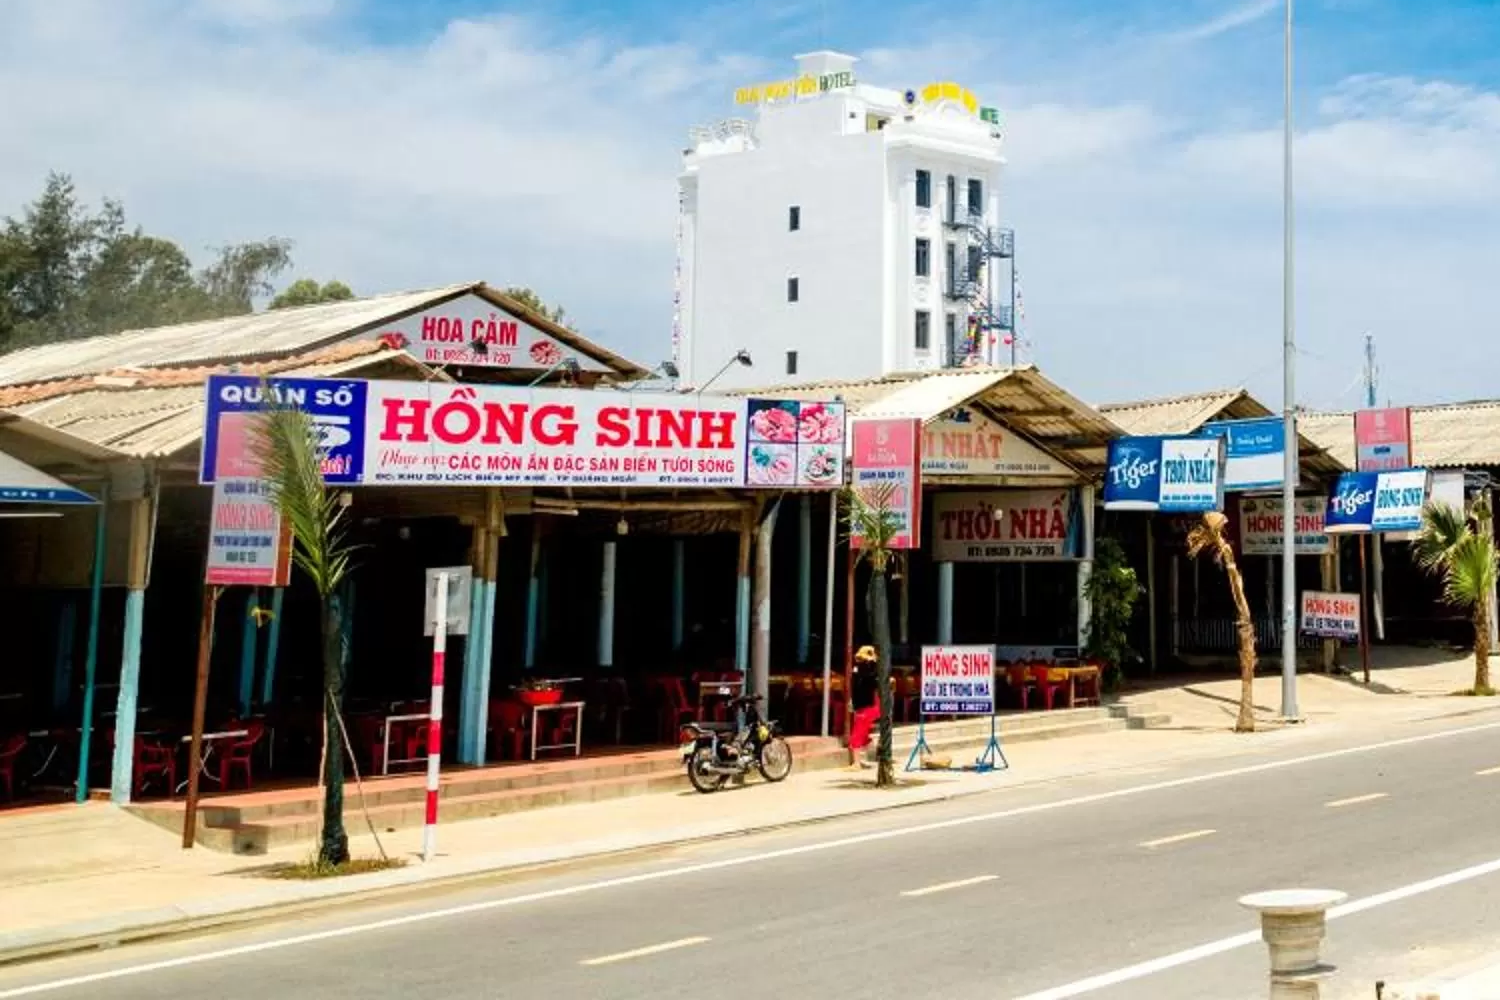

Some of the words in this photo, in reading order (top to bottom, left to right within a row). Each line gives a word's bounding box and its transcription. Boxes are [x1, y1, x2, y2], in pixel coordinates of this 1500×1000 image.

[421, 316, 464, 343] HOA
[315, 383, 354, 406] SỐ
[380, 387, 579, 446] HỒNG
[596, 405, 736, 449] SINH
[942, 420, 1003, 458] NHẤT
[449, 452, 481, 470] CÁC
[487, 452, 522, 471] MÓN
[528, 452, 549, 470] ĂN
[553, 453, 584, 474] ĐẶC
[589, 452, 619, 471] SẢN
[623, 452, 657, 472] BIỂN
[1110, 457, 1158, 489] Tiger
[398, 473, 423, 481] KHU
[426, 473, 442, 481] DU
[1331, 487, 1373, 515] Tiger
[962, 653, 989, 676] SINH
[938, 683, 947, 696] XE
